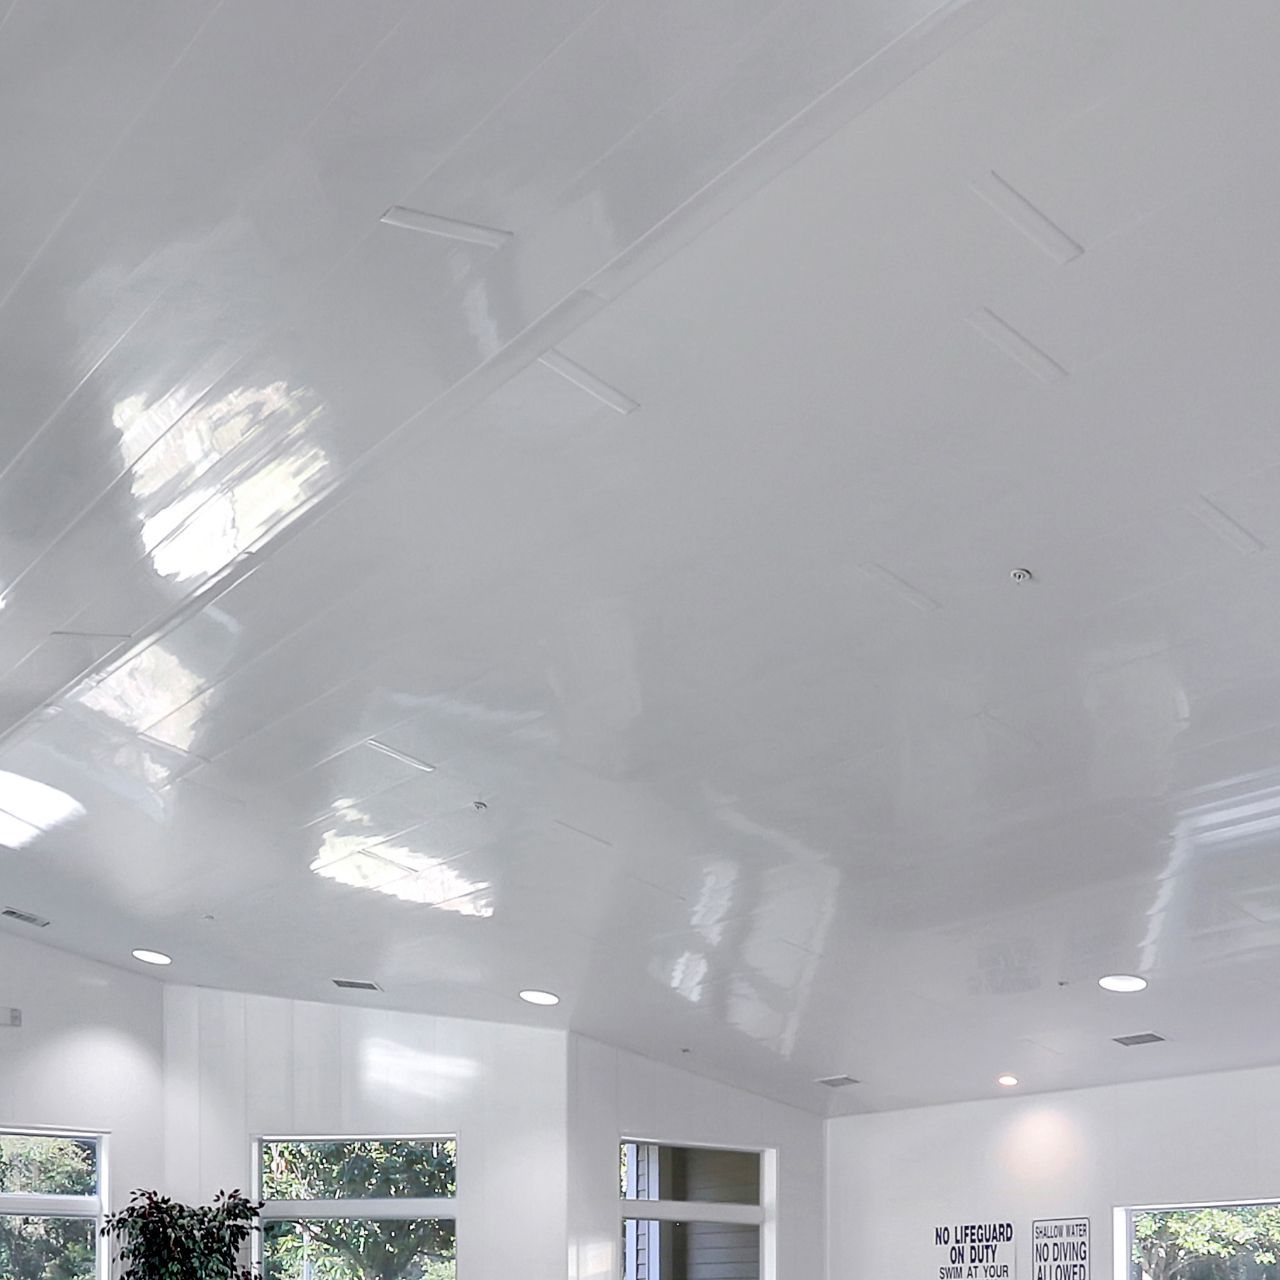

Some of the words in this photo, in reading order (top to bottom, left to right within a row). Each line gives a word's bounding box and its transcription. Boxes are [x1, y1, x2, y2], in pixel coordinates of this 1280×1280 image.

[935, 1227, 950, 1245] NO
[954, 1223, 1013, 1245] LIFEGUARD
[950, 1246, 964, 1265] ON
[970, 1244, 997, 1264] DUTY
[1035, 1242, 1049, 1263] NO
[1053, 1241, 1087, 1262] DIVING
[939, 1266, 963, 1280] SWIM
[967, 1265, 979, 1279] AT
[983, 1264, 1009, 1278] YOUR
